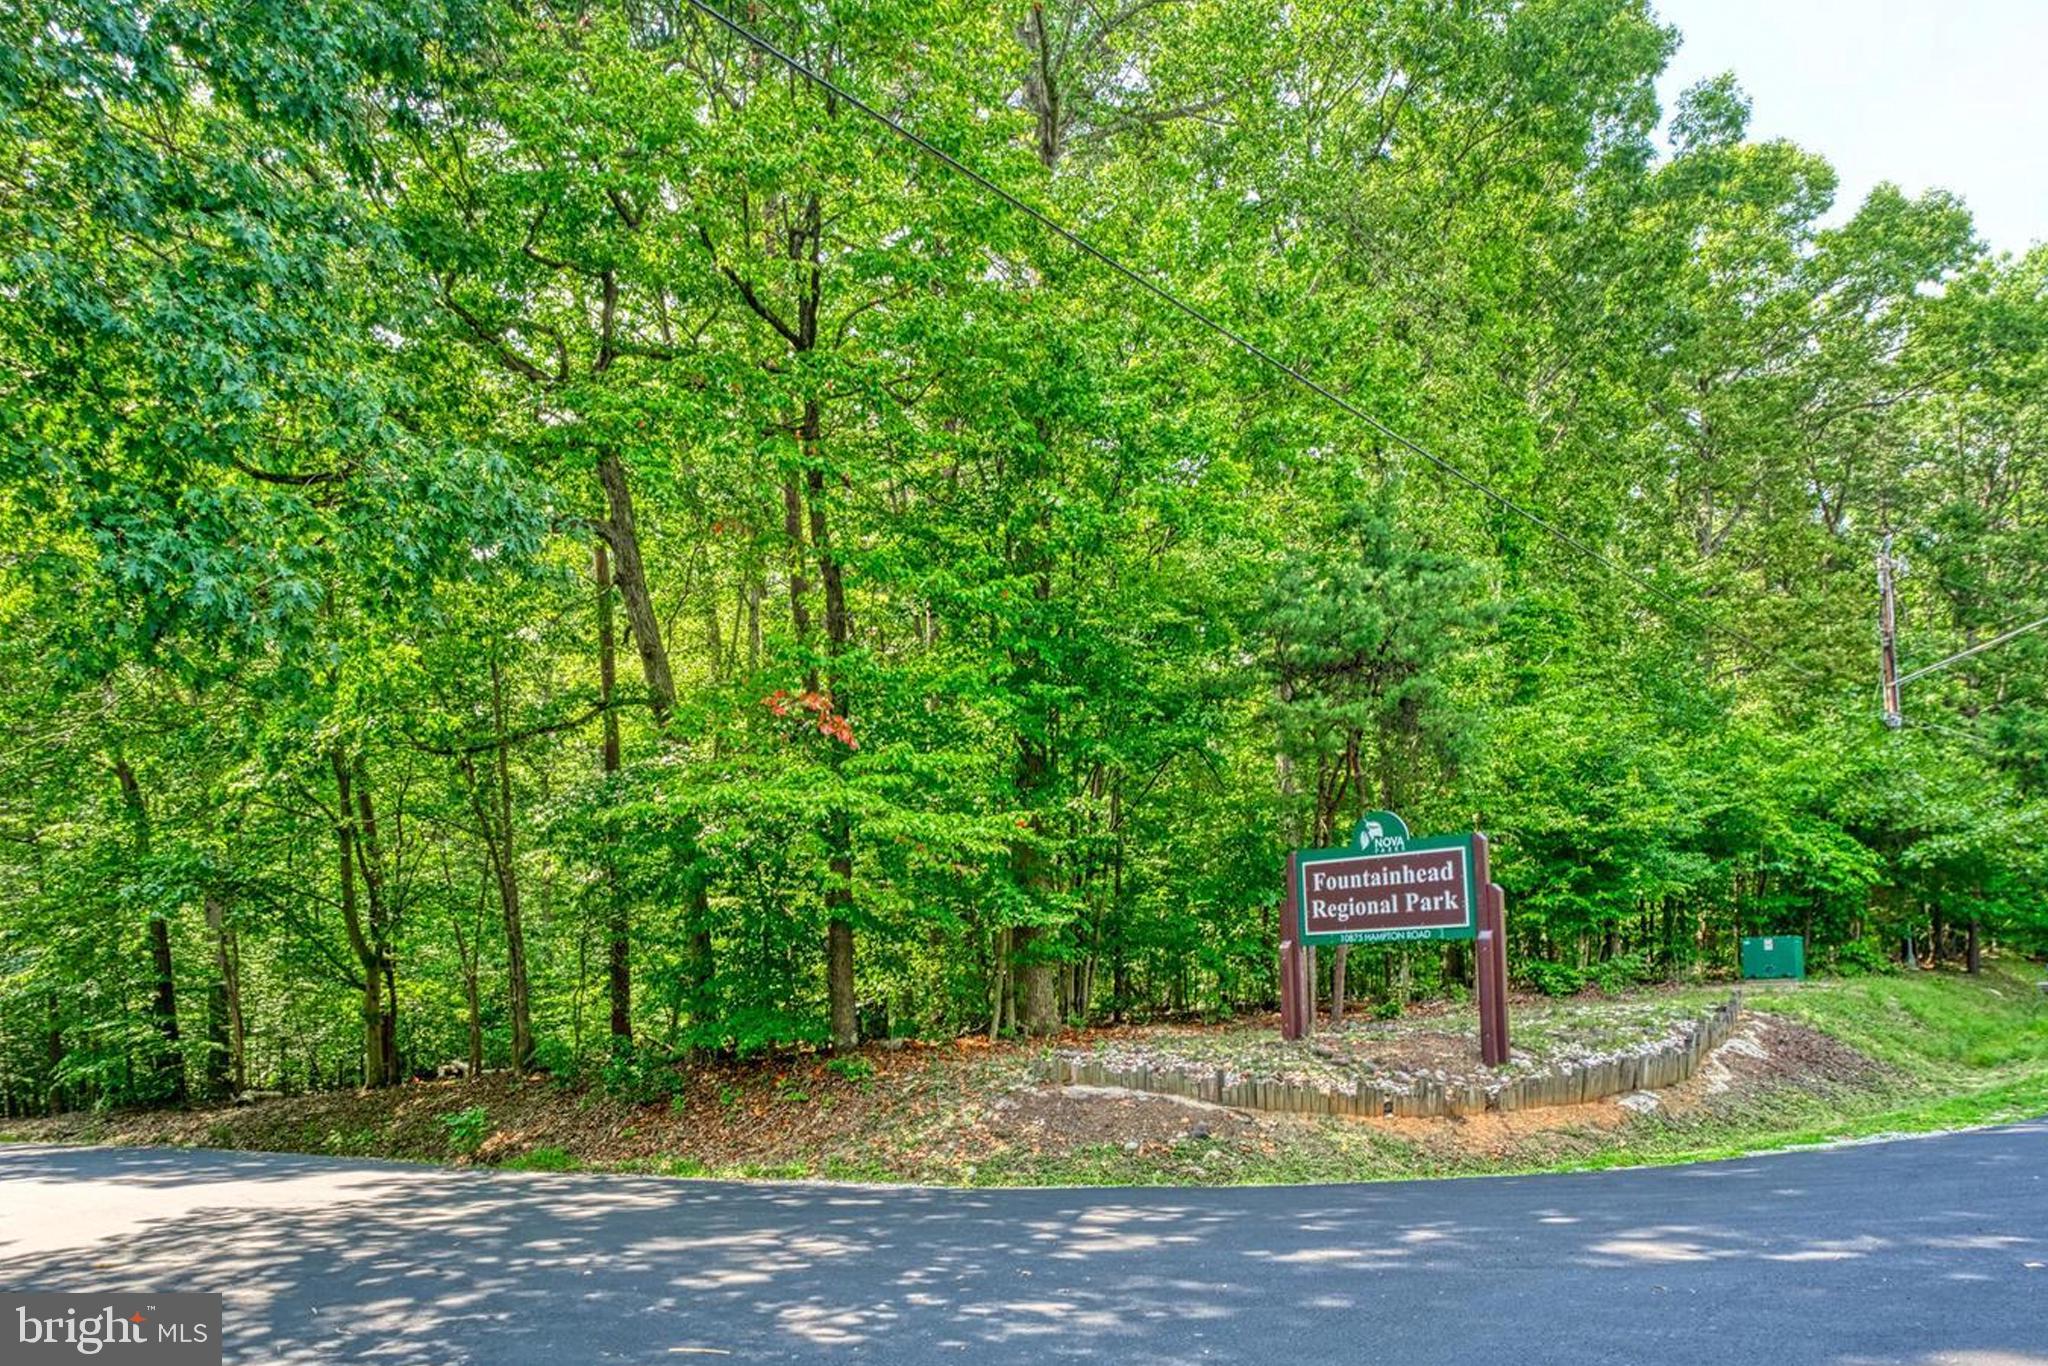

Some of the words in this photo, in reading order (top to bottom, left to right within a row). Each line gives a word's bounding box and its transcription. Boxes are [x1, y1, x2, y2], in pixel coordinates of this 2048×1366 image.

[1374, 836, 1404, 848] NOVA
[1313, 861, 1453, 891] Fountainhead
[1311, 894, 1398, 921] Regional
[1405, 891, 1459, 912] Park
[1340, 933, 1363, 943] 10875
[1364, 931, 1405, 942] HAMPTON
[1406, 929, 1431, 940] ROAD
